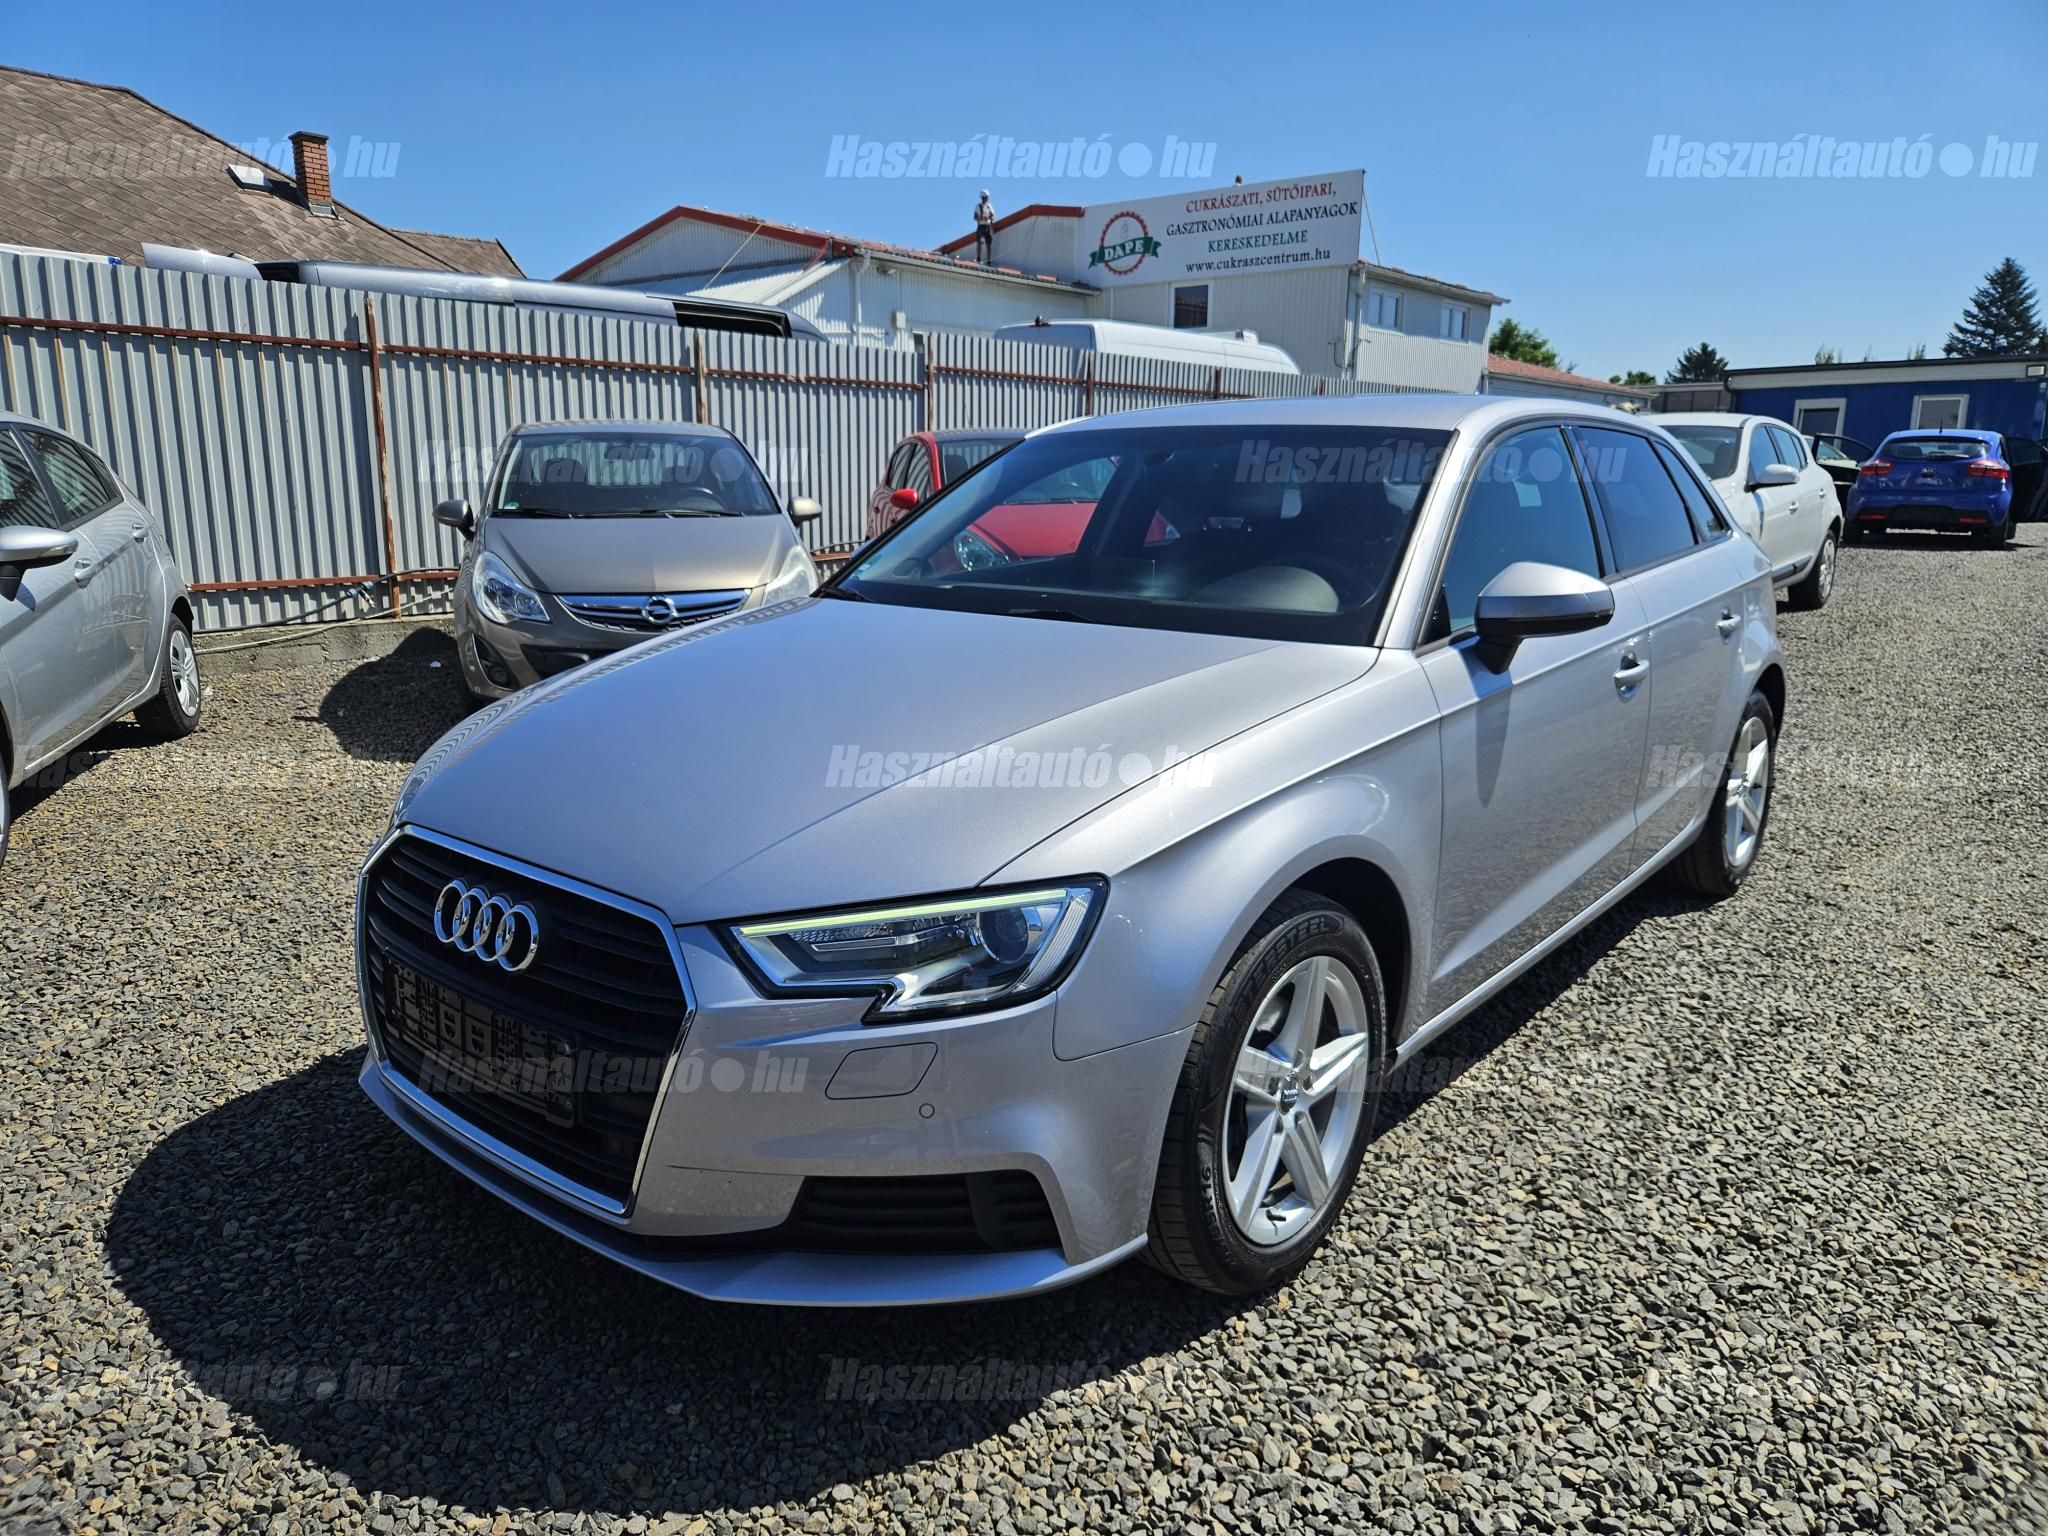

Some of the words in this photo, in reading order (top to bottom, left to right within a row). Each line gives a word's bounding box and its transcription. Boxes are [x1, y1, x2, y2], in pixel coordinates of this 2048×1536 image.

[1186, 192, 1263, 213] CUKRÁSZATI,
[1266, 182, 1336, 204] SÜTŐIPARI,
[1166, 213, 1264, 236] GASZTRONÓMIAI
[1267, 201, 1359, 225] ALAPANYAGOK
[1104, 240, 1144, 260] DAPE
[1208, 230, 1308, 253] KERESKEDELME
[1186, 248, 1331, 272] www.cukraszcentrum.hu
